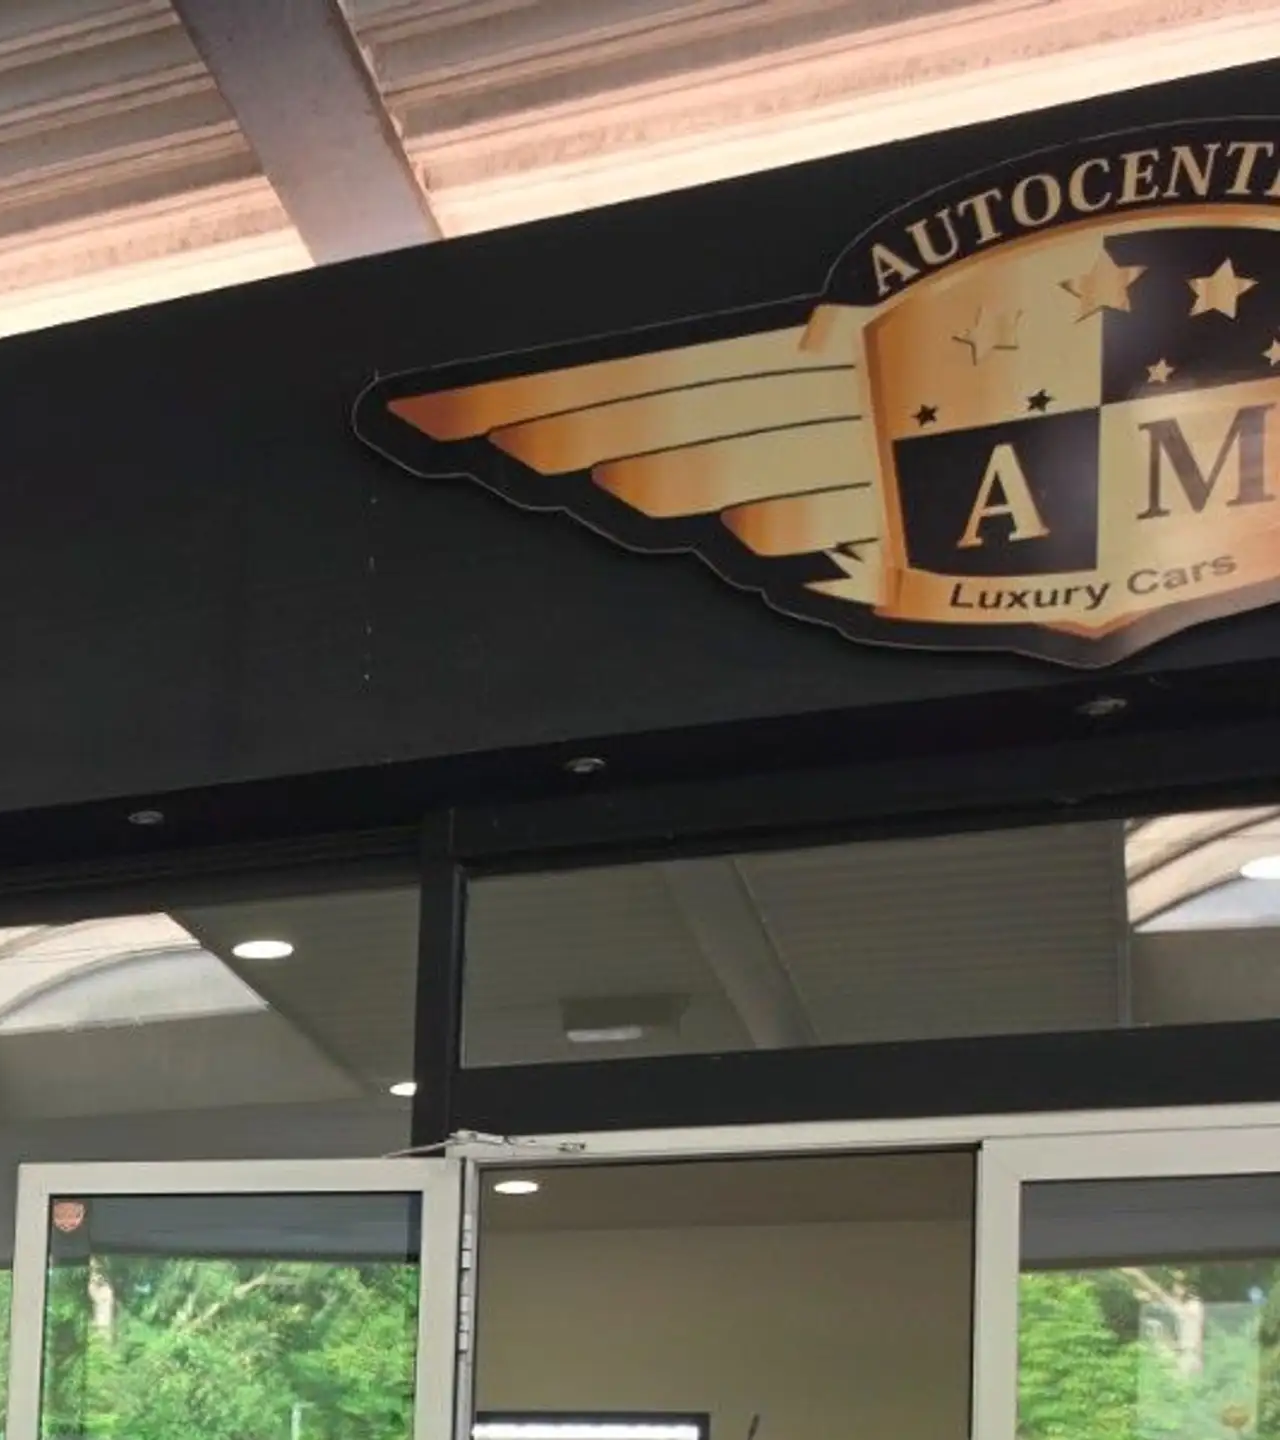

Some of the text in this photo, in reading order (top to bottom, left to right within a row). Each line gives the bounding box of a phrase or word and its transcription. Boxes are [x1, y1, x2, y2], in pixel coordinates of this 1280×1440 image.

[956, 402, 1277, 548] A M
[948, 554, 1238, 610] Luxury Cars
